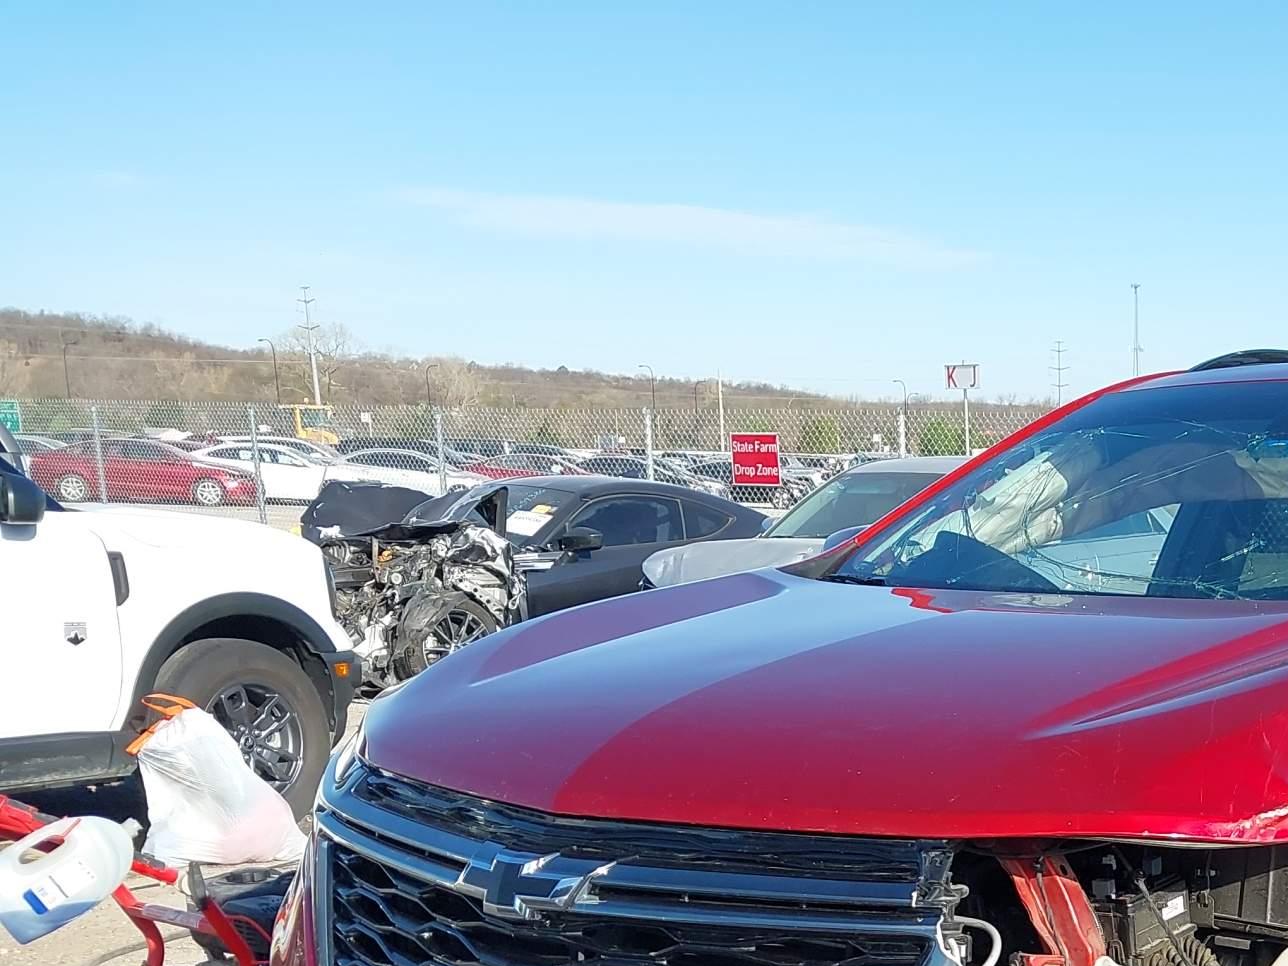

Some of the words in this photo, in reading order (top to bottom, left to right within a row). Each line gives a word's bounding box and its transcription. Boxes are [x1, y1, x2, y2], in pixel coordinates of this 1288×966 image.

[946, 365, 958, 389] K
[970, 365, 977, 388] J
[732, 440, 754, 453] State
[754, 441, 777, 453] Farm
[734, 464, 755, 478] Drop
[756, 464, 778, 476] Zone
